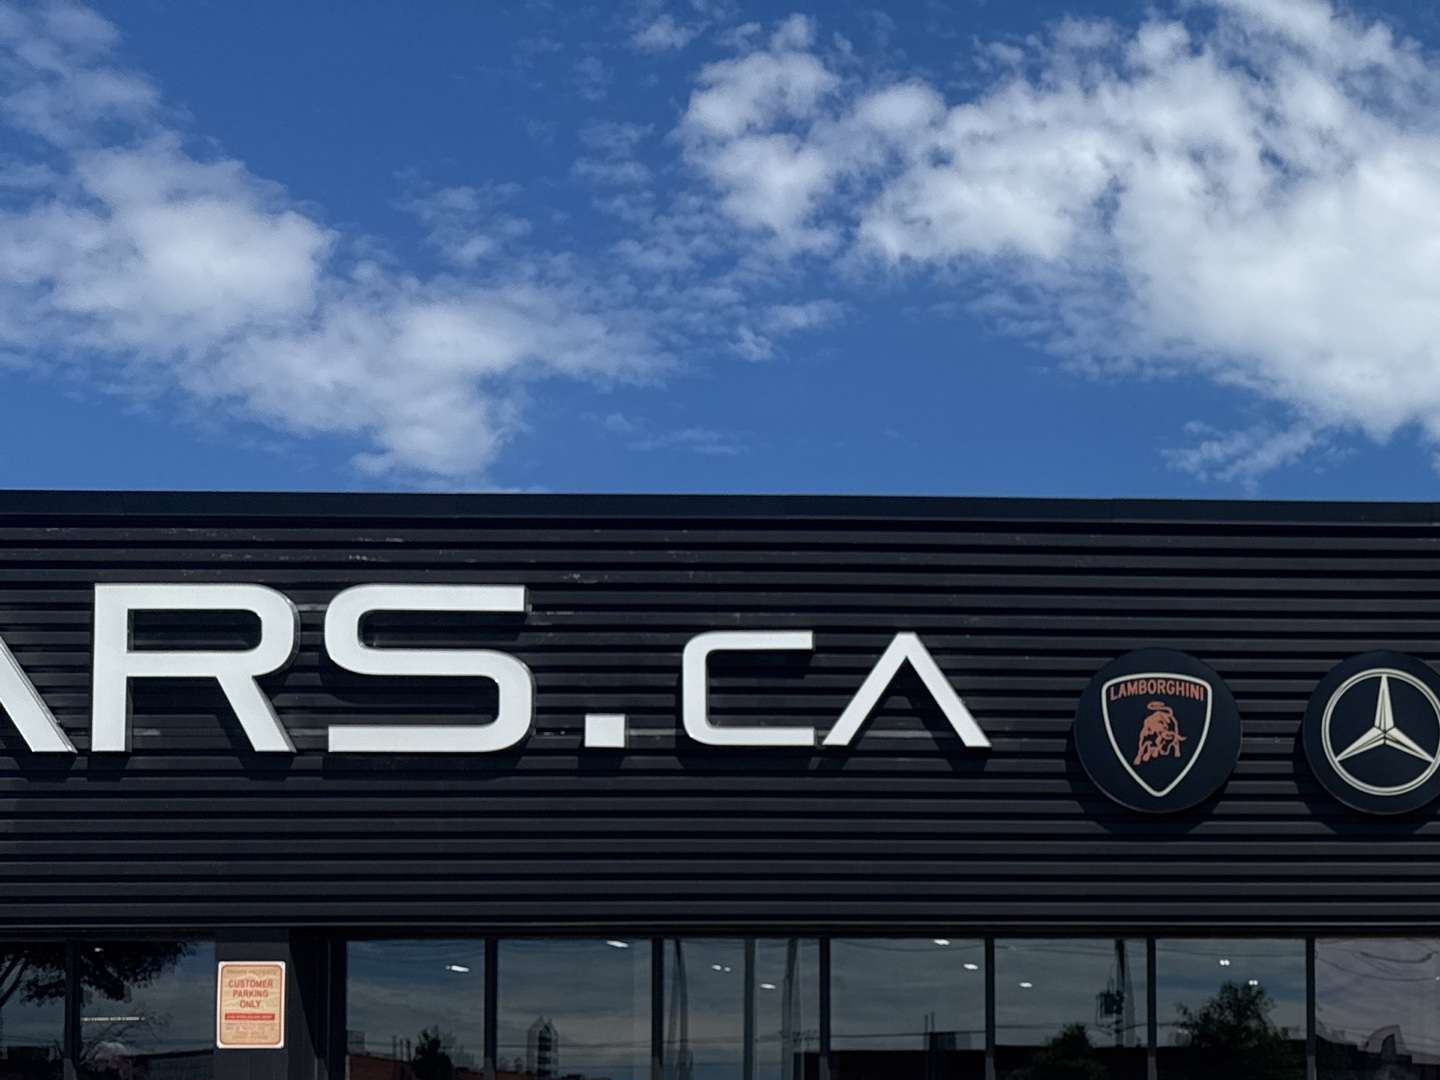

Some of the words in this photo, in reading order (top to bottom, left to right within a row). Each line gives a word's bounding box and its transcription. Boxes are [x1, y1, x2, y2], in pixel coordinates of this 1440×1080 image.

[1109, 678, 1205, 701] LAMBORGHINI
[228, 979, 273, 988] CUSTOMER
[232, 989, 269, 998] PARKING
[239, 999, 262, 1008] ONLY
